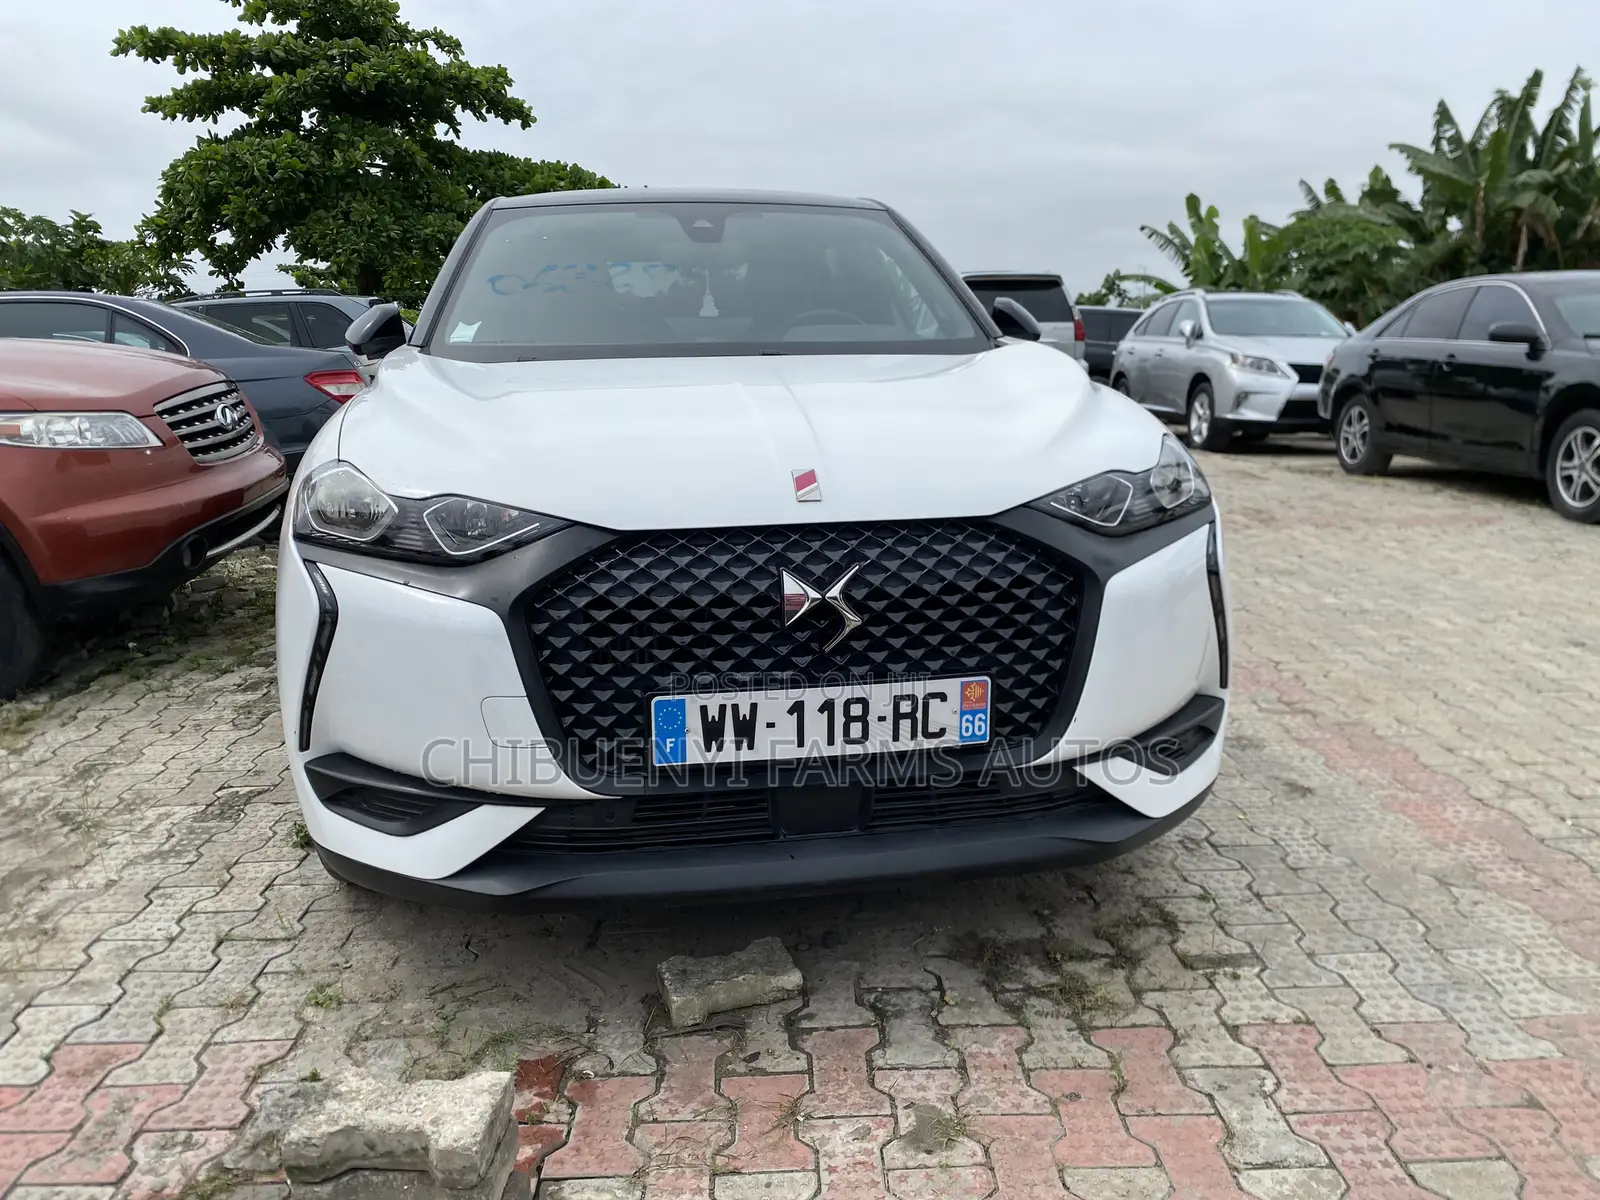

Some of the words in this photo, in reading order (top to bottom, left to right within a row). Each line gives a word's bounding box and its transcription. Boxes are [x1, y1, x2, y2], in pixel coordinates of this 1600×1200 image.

[699, 691, 947, 753] WW-118-RC
[961, 713, 986, 737] 66
[665, 738, 676, 752] F
